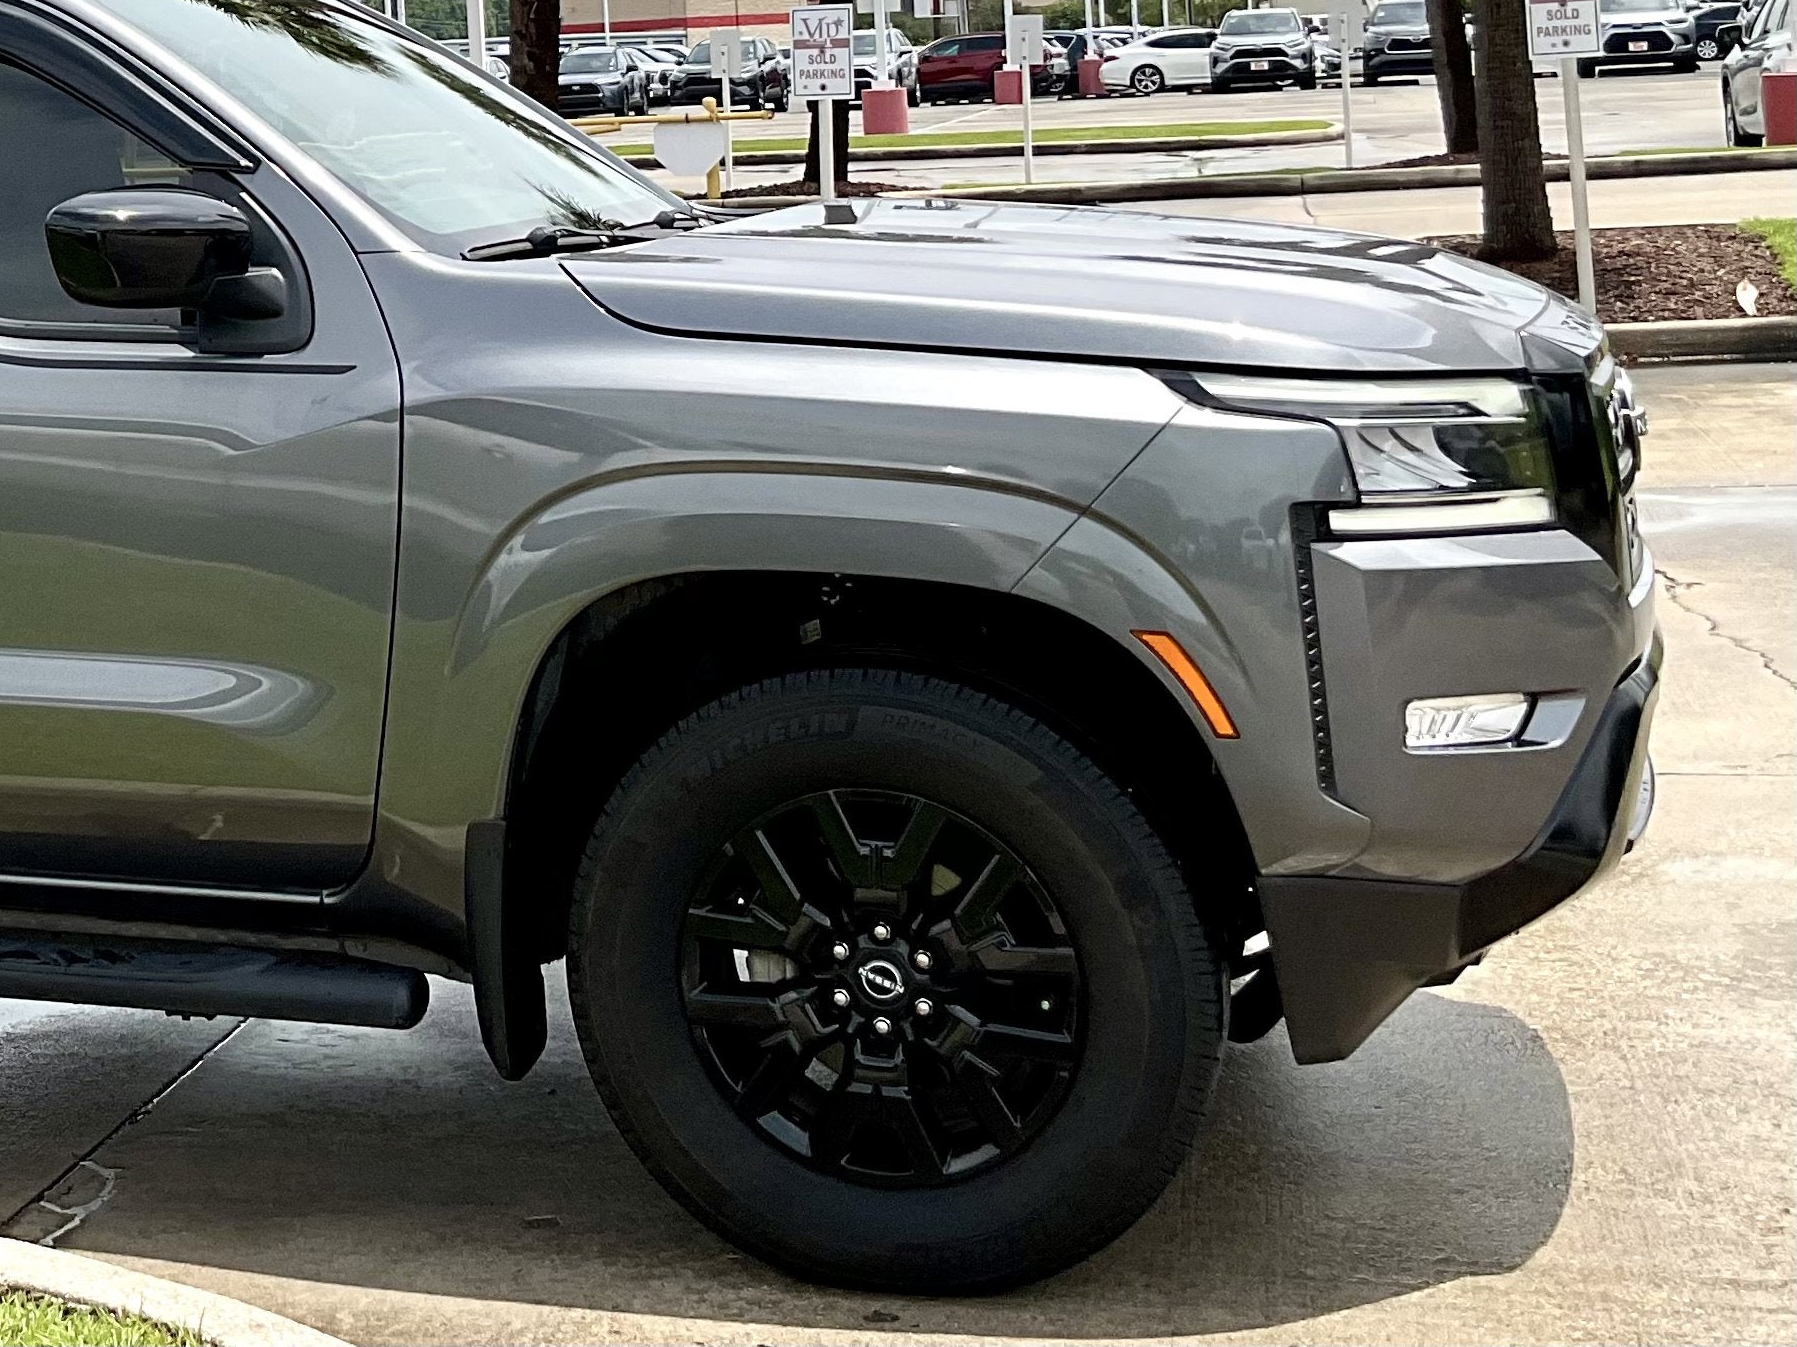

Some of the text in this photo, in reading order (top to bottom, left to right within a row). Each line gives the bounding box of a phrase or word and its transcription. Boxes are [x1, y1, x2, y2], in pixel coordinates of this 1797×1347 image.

[1546, 8, 1579, 21] SOLD
[1536, 24, 1592, 38] PARKING
[807, 54, 836, 65] SOLD
[799, 68, 846, 79] PARKING
